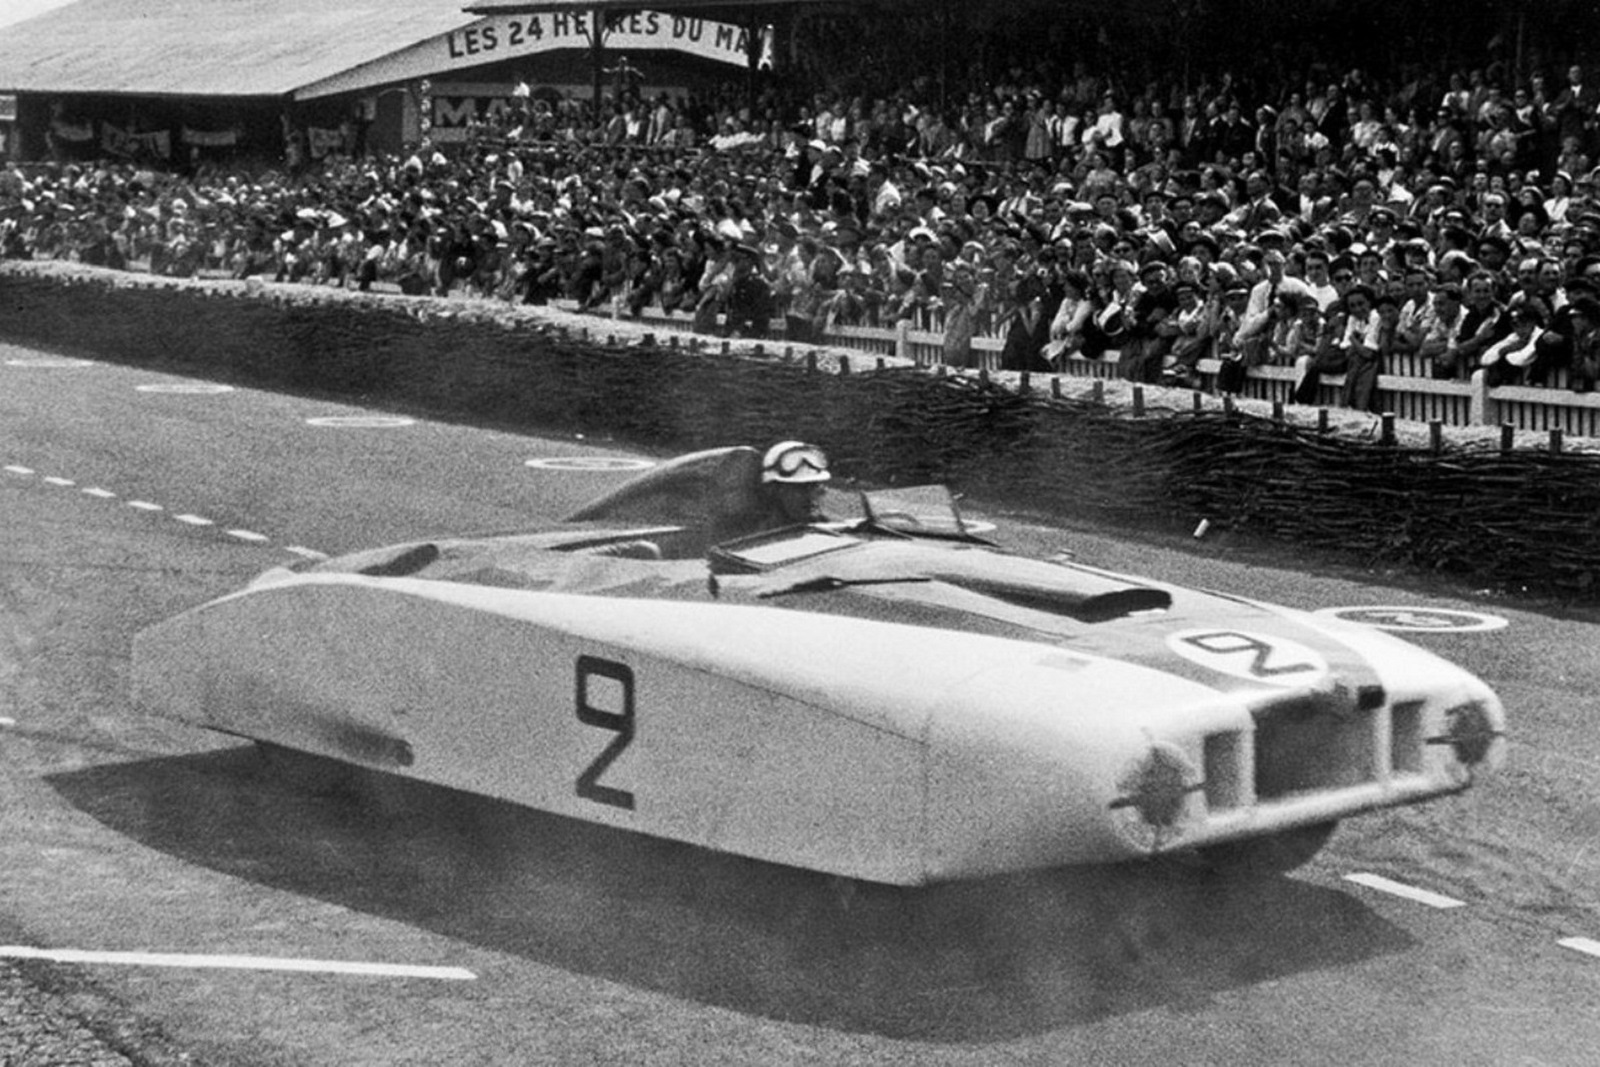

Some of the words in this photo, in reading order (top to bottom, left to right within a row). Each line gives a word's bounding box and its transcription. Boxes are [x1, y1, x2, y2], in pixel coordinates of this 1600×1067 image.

[448, 26, 498, 58] LES
[508, 16, 544, 46] 24
[553, 12, 659, 37] HERES
[673, 15, 703, 42] DU
[716, 25, 750, 53] MA
[1181, 631, 1317, 678] 2
[575, 654, 635, 811] 2
